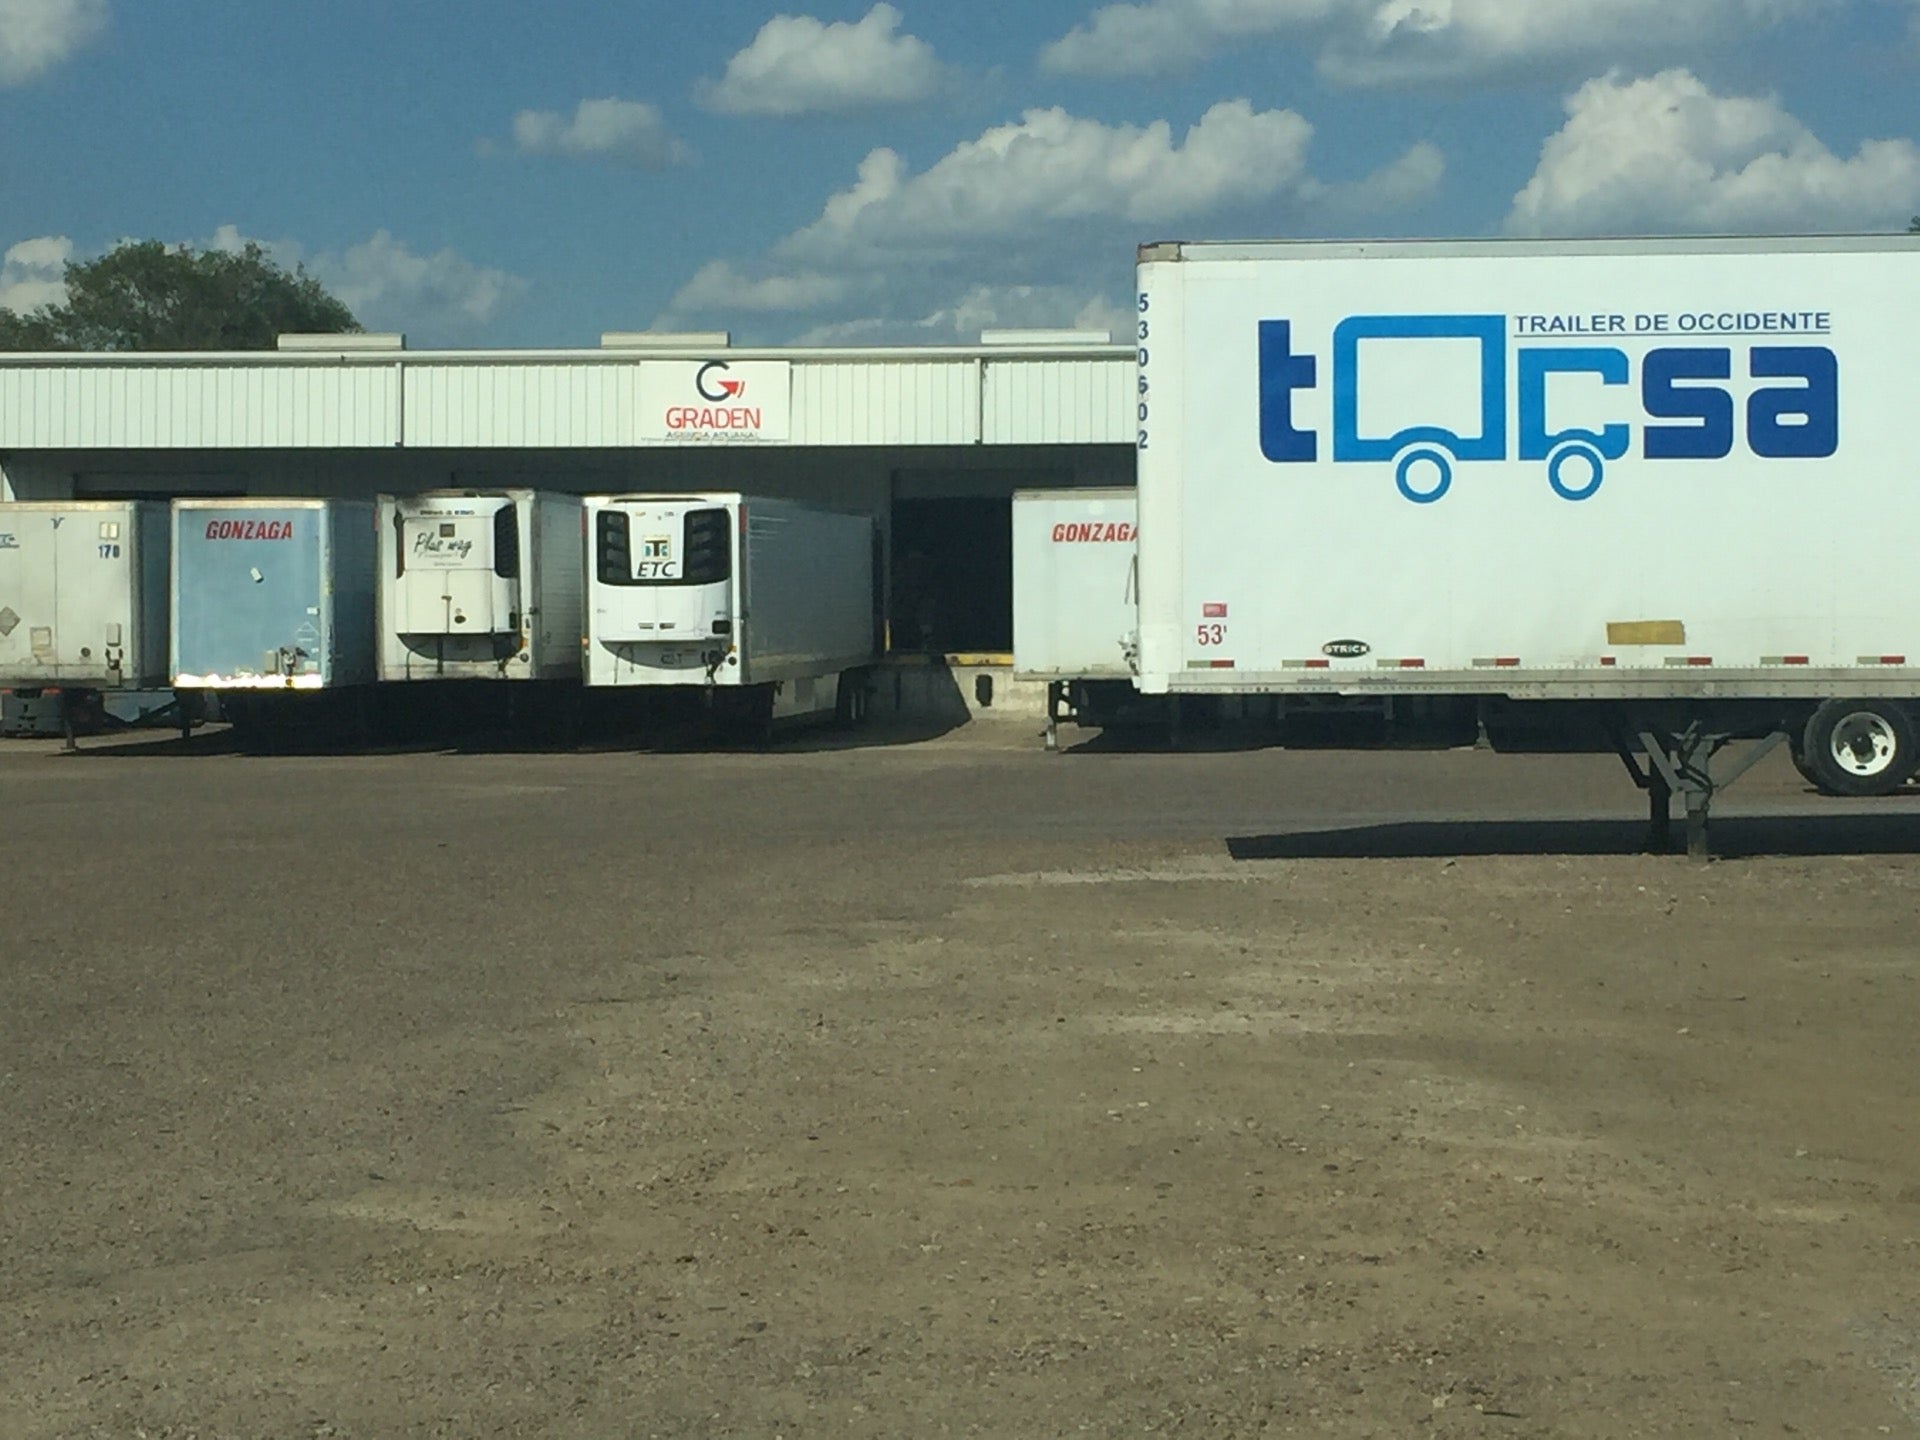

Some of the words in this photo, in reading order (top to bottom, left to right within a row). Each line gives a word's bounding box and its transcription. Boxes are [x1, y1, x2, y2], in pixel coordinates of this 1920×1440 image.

[1517, 315, 1625, 332] TRAILER
[1634, 314, 1669, 331] DE
[1677, 312, 1831, 331] OCCIDENTE
[665, 407, 761, 429] GRADEN
[206, 520, 292, 540] GONZAGA
[637, 561, 677, 577] ETC
[1197, 623, 1228, 646] 53'
